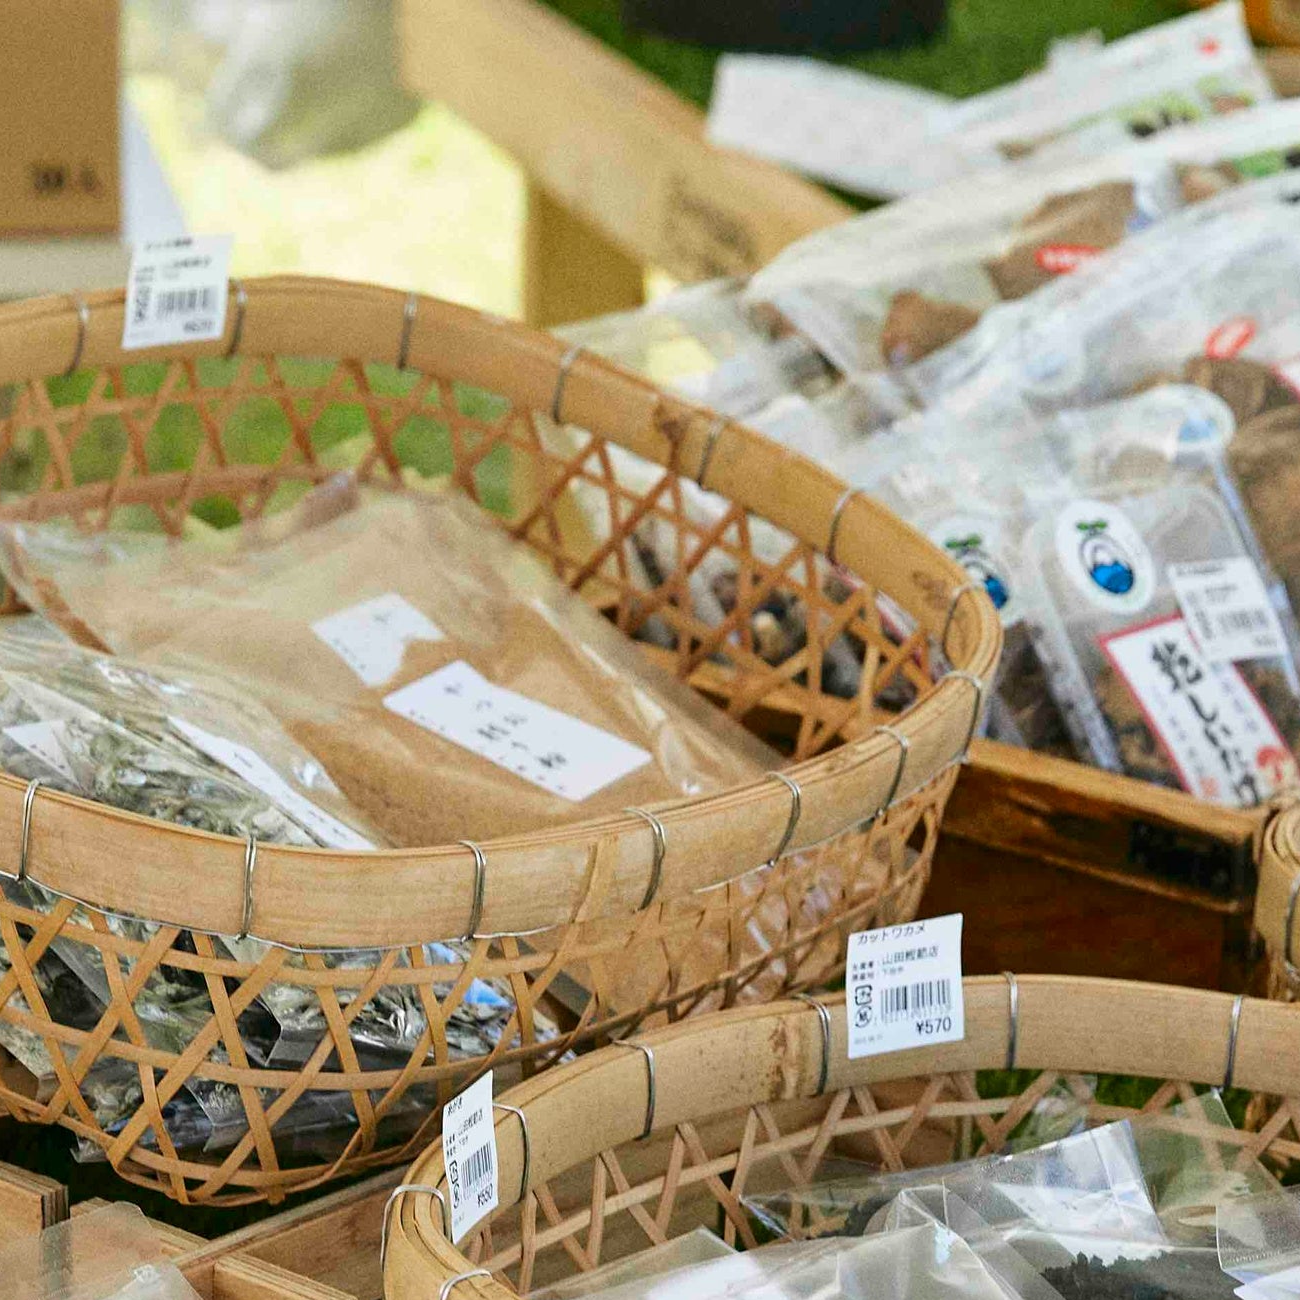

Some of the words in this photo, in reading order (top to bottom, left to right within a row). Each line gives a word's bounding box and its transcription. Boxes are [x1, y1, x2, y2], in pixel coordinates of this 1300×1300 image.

[857, 924, 925, 945] カットワカメ
[915, 1017, 951, 1035] ¥570
